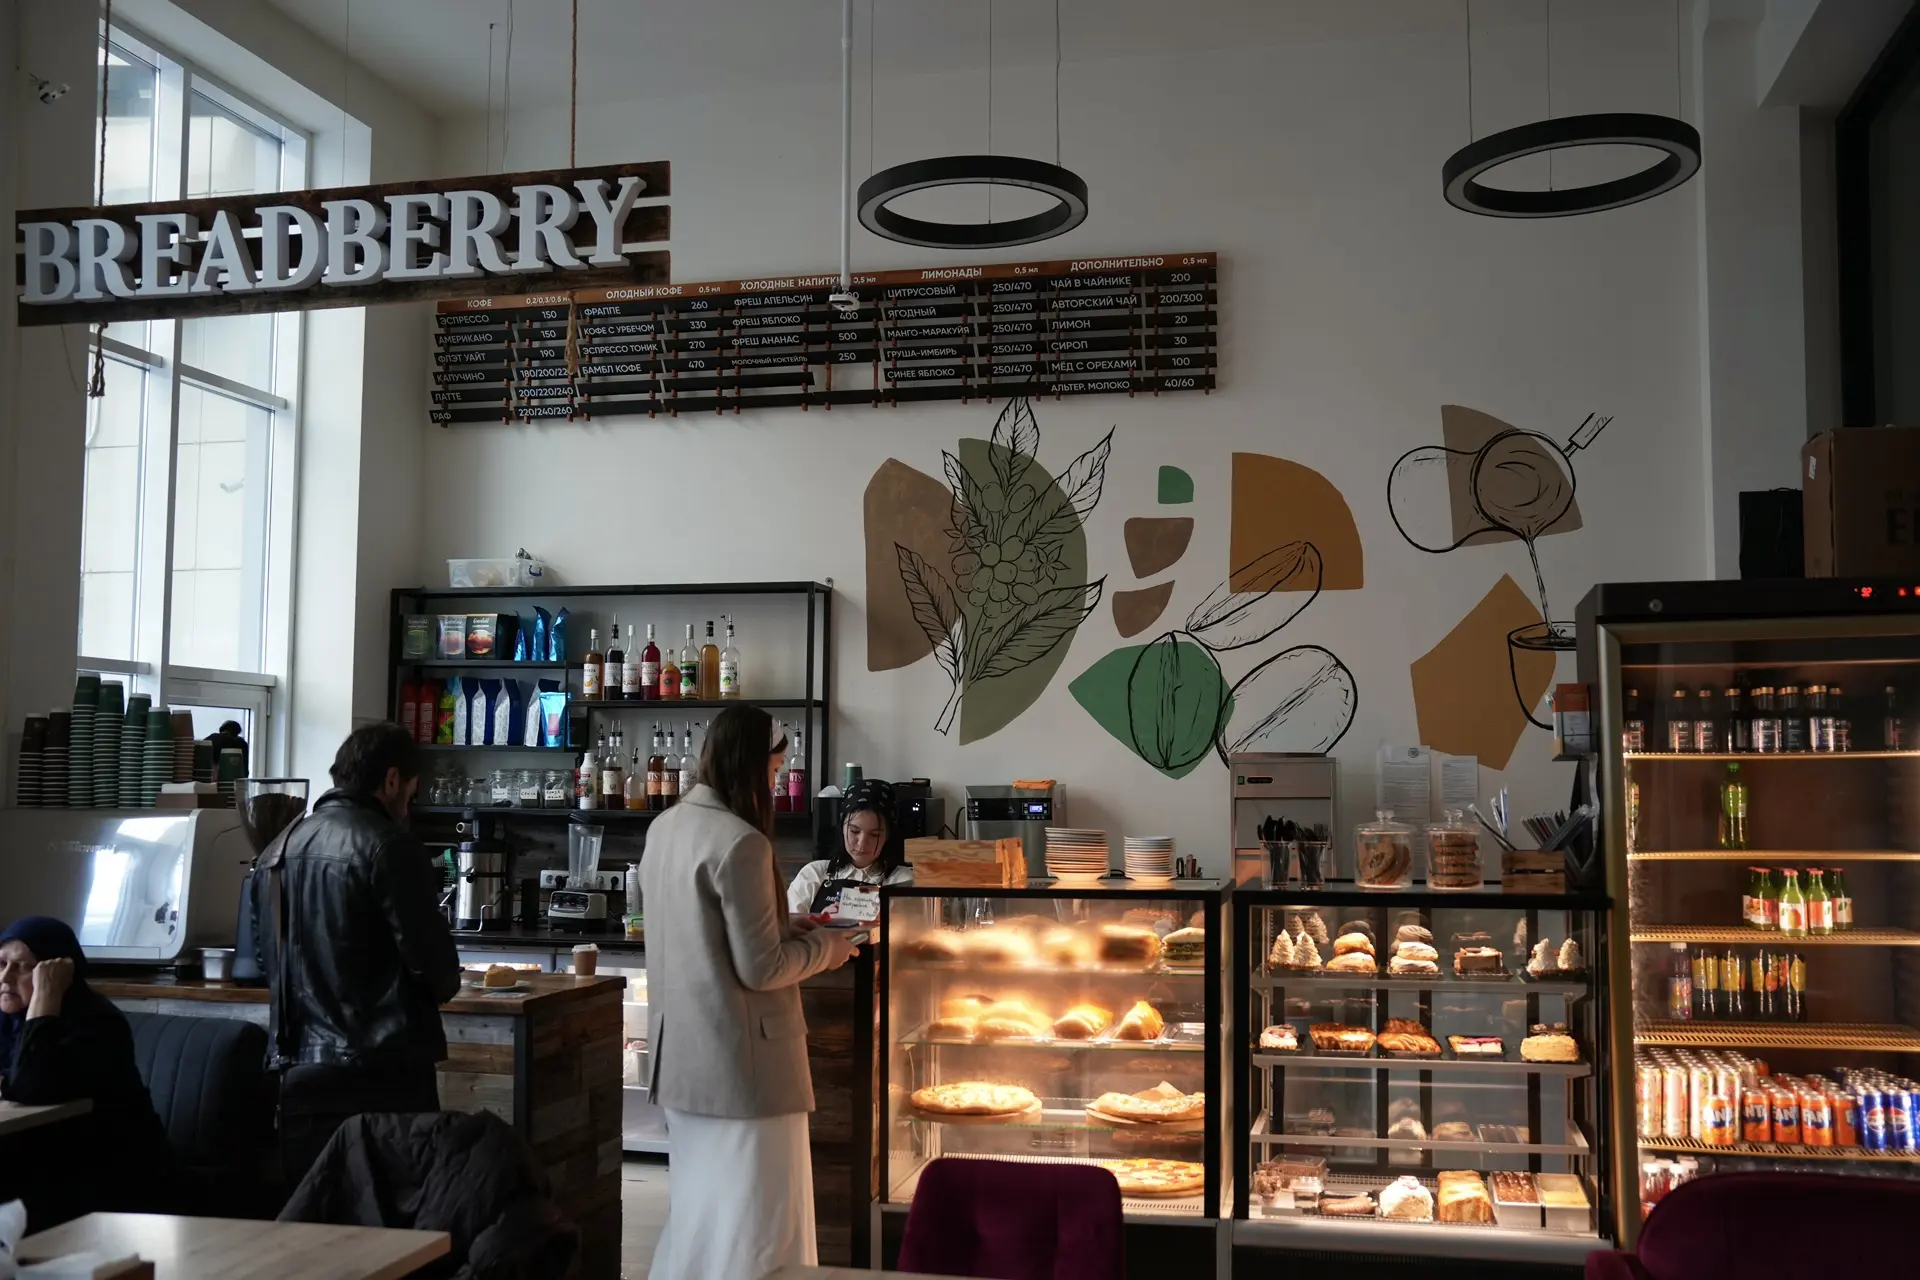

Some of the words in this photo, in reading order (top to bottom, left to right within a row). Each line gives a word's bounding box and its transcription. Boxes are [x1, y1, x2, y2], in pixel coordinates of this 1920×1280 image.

[20, 176, 645, 306] BREADBERRY
[1071, 257, 1164, 272] ДОПОЛНИТЕЛЬНО
[921, 267, 982, 280] ЛИМОНАДЫ
[1051, 279, 1072, 289] ЧАЙ
[1075, 279, 1081, 287] В
[1084, 276, 1131, 286] ЧАЙНИКЕ
[1171, 273, 1190, 282] 200
[741, 278, 795, 291] ХОЛОДНЫЕ
[887, 285, 955, 298] ЦИТРУСОВЫЙ
[993, 282, 1032, 292] 250/470
[606, 286, 654, 299] ОЛОДНЫЙ
[656, 286, 682, 296] КОФЕ
[698, 286, 710, 294] 0,5
[467, 298, 492, 308] КОФЕ
[584, 306, 621, 316] ФРАППЕ
[691, 300, 708, 309] 260
[734, 297, 761, 307] ФРЕШ
[764, 294, 813, 305] АПЕЛЬСИН
[1051, 297, 1113, 310] АВТОРСКИЙ
[1116, 295, 1137, 305] ЧАЙ
[1160, 293, 1203, 304] 200/300
[439, 315, 489, 325] ЭСПРЕССО
[542, 310, 557, 319] 150
[888, 307, 936, 319] ЯГОДНЫЙ
[993, 303, 1032, 313] 250/470
[733, 317, 760, 327] ФРЕШ
[762, 315, 800, 325] ЯБЛОКО
[840, 312, 858, 320] 400
[1052, 320, 1091, 330] ЛИМОН
[1175, 315, 1188, 324] 20
[584, 326, 606, 335] КОФЕ
[608, 325, 613, 334] С
[616, 323, 654, 334] УРБЕЧОМ
[690, 320, 707, 329] 330
[887, 326, 970, 338] МАНГО-МАРАКУЙЯ
[993, 323, 1032, 333] 250/470
[438, 333, 493, 344] АМЕРИКАНО
[541, 330, 556, 339] 150
[732, 337, 759, 347] ФРЕШ
[761, 335, 799, 345] АНАНАС
[839, 332, 857, 341] 500
[1051, 341, 1088, 351] СИРОП
[1175, 336, 1187, 345] 30
[583, 344, 627, 355] ЭСПРЕССО
[629, 343, 658, 352] ТОНИК
[689, 340, 705, 349] 270
[887, 347, 957, 359] ГРУША-ИМБИРЬ
[992, 344, 1032, 353] 250/470
[438, 353, 462, 363] ФЛЭТ
[464, 351, 486, 362] УАЙТ
[540, 349, 555, 358] 190
[732, 357, 771, 366] МОЛОЧНЫЙ
[773, 354, 807, 364] КОКТЕЙЛЬ
[838, 352, 856, 361] 250
[582, 364, 612, 374] БАМБЛ
[615, 363, 641, 373] КОФЕ
[689, 359, 705, 369] 470
[887, 369, 916, 379] СИНЕЕ
[918, 368, 955, 377] ЯБЛОКО
[993, 364, 1032, 374] 250/470
[1052, 361, 1073, 372] МЁД
[1076, 362, 1083, 370] С
[1087, 359, 1136, 370] ОРЕХАМИ
[1172, 357, 1190, 366] 100
[436, 372, 485, 382] КАПУЧИНО
[1051, 383, 1086, 392] АЛЬТЕР.
[1088, 380, 1130, 391] МОЛОКО
[1165, 379, 1194, 388] 40/60
[435, 392, 462, 401] ЛАТТЕ
[518, 387, 573, 397] 200/220/240
[433, 412, 452, 420] РАФ
[518, 406, 573, 416] 220/240/260
